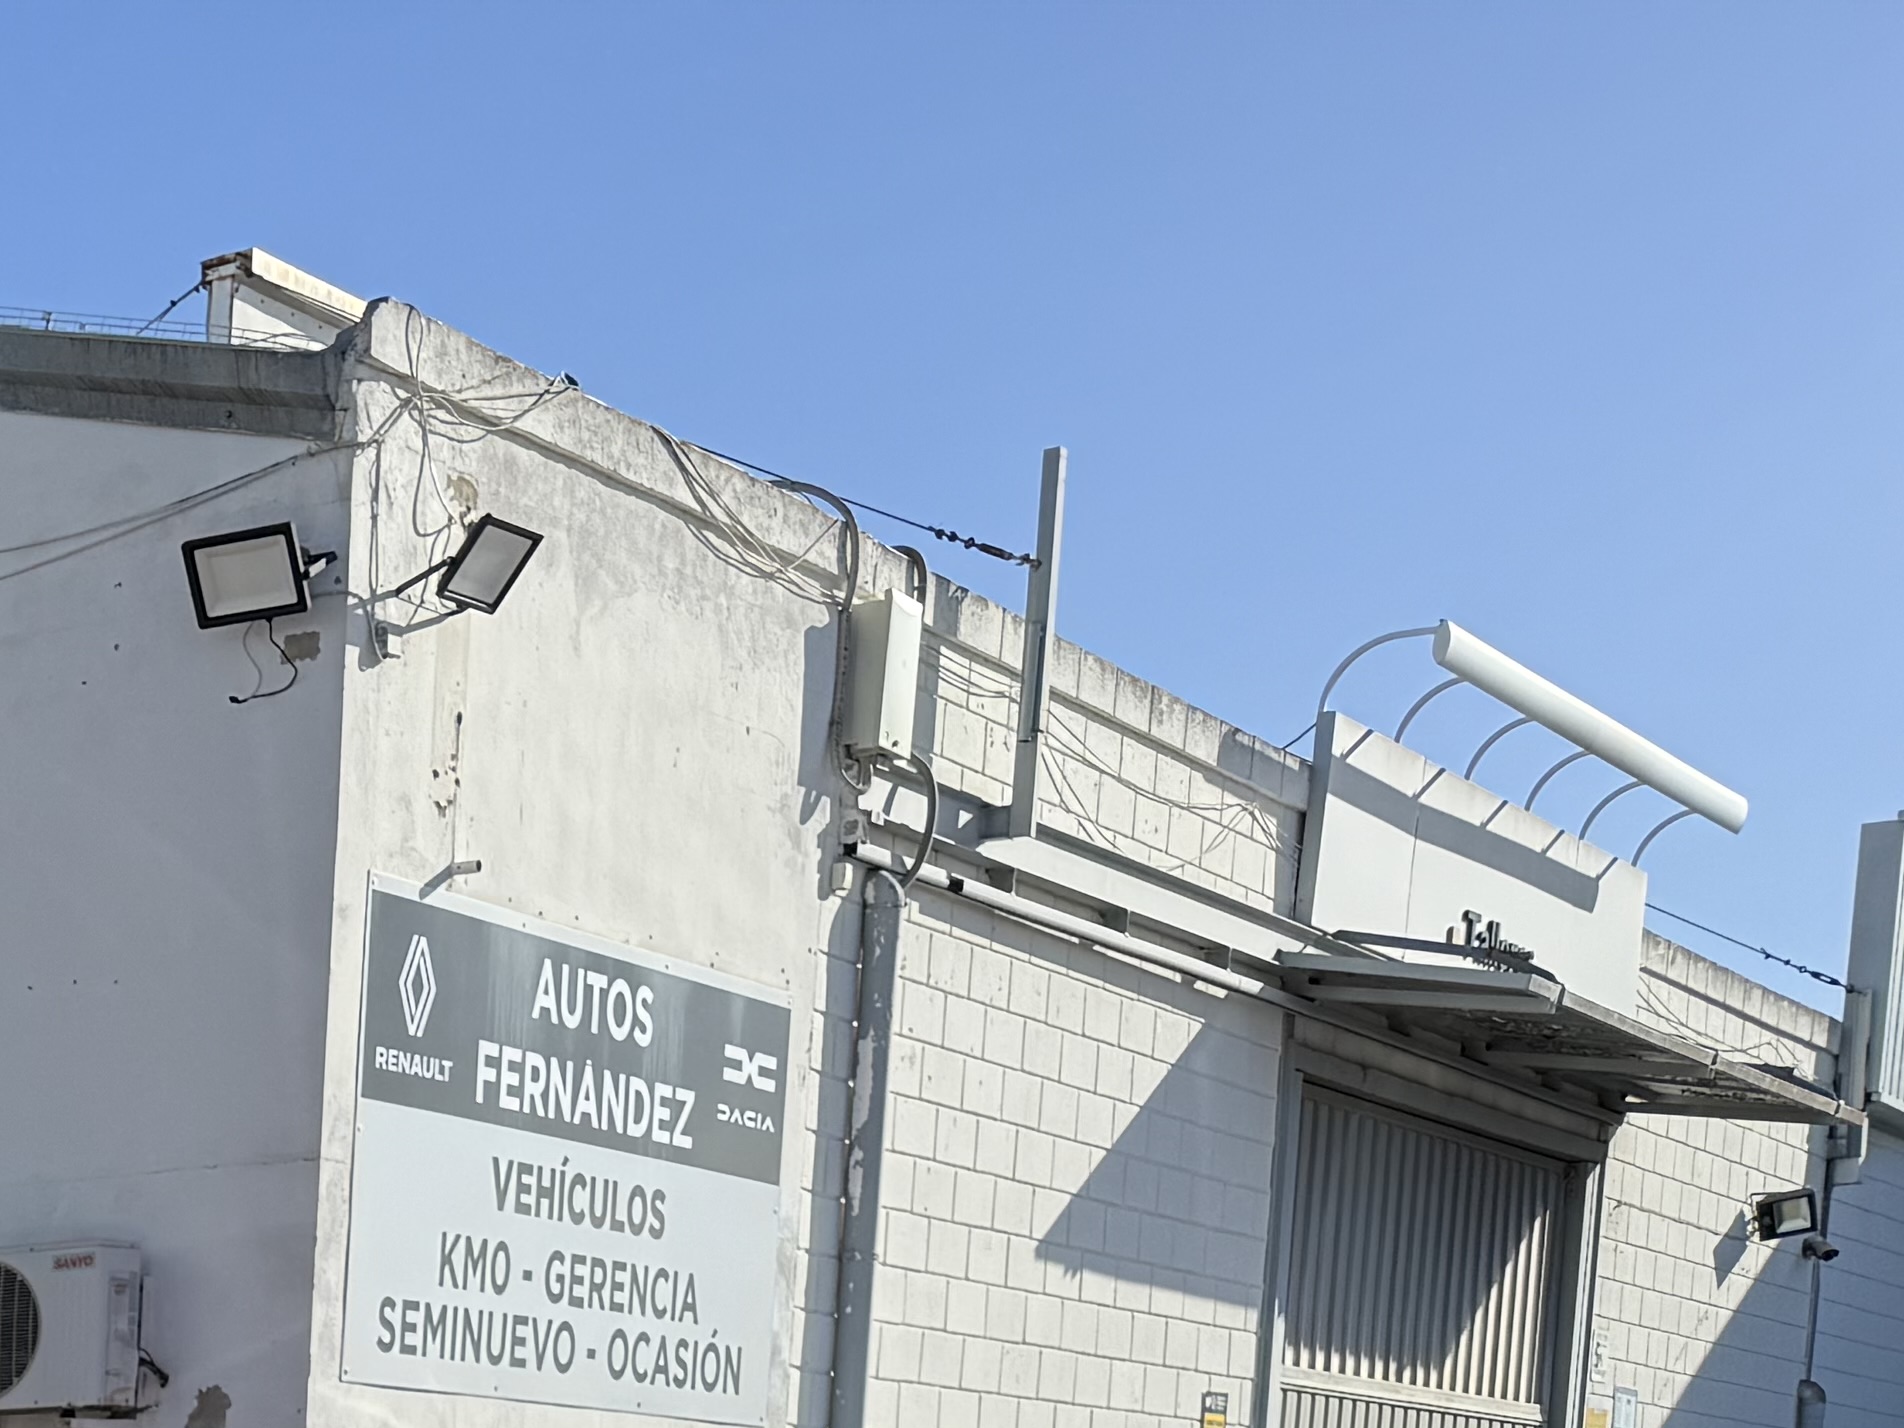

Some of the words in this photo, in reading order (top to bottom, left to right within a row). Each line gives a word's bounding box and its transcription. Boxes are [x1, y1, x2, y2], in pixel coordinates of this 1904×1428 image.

[532, 958, 654, 1047] AUTOS
[374, 1047, 453, 1082] RENAULT
[717, 1103, 775, 1133] DACIA
[492, 1156, 666, 1240] VEHÍCULOS
[544, 1250, 699, 1325] GERENCIA
[376, 1296, 576, 1374] SEMINUEVO
[607, 1328, 743, 1396] OCASIÓN
